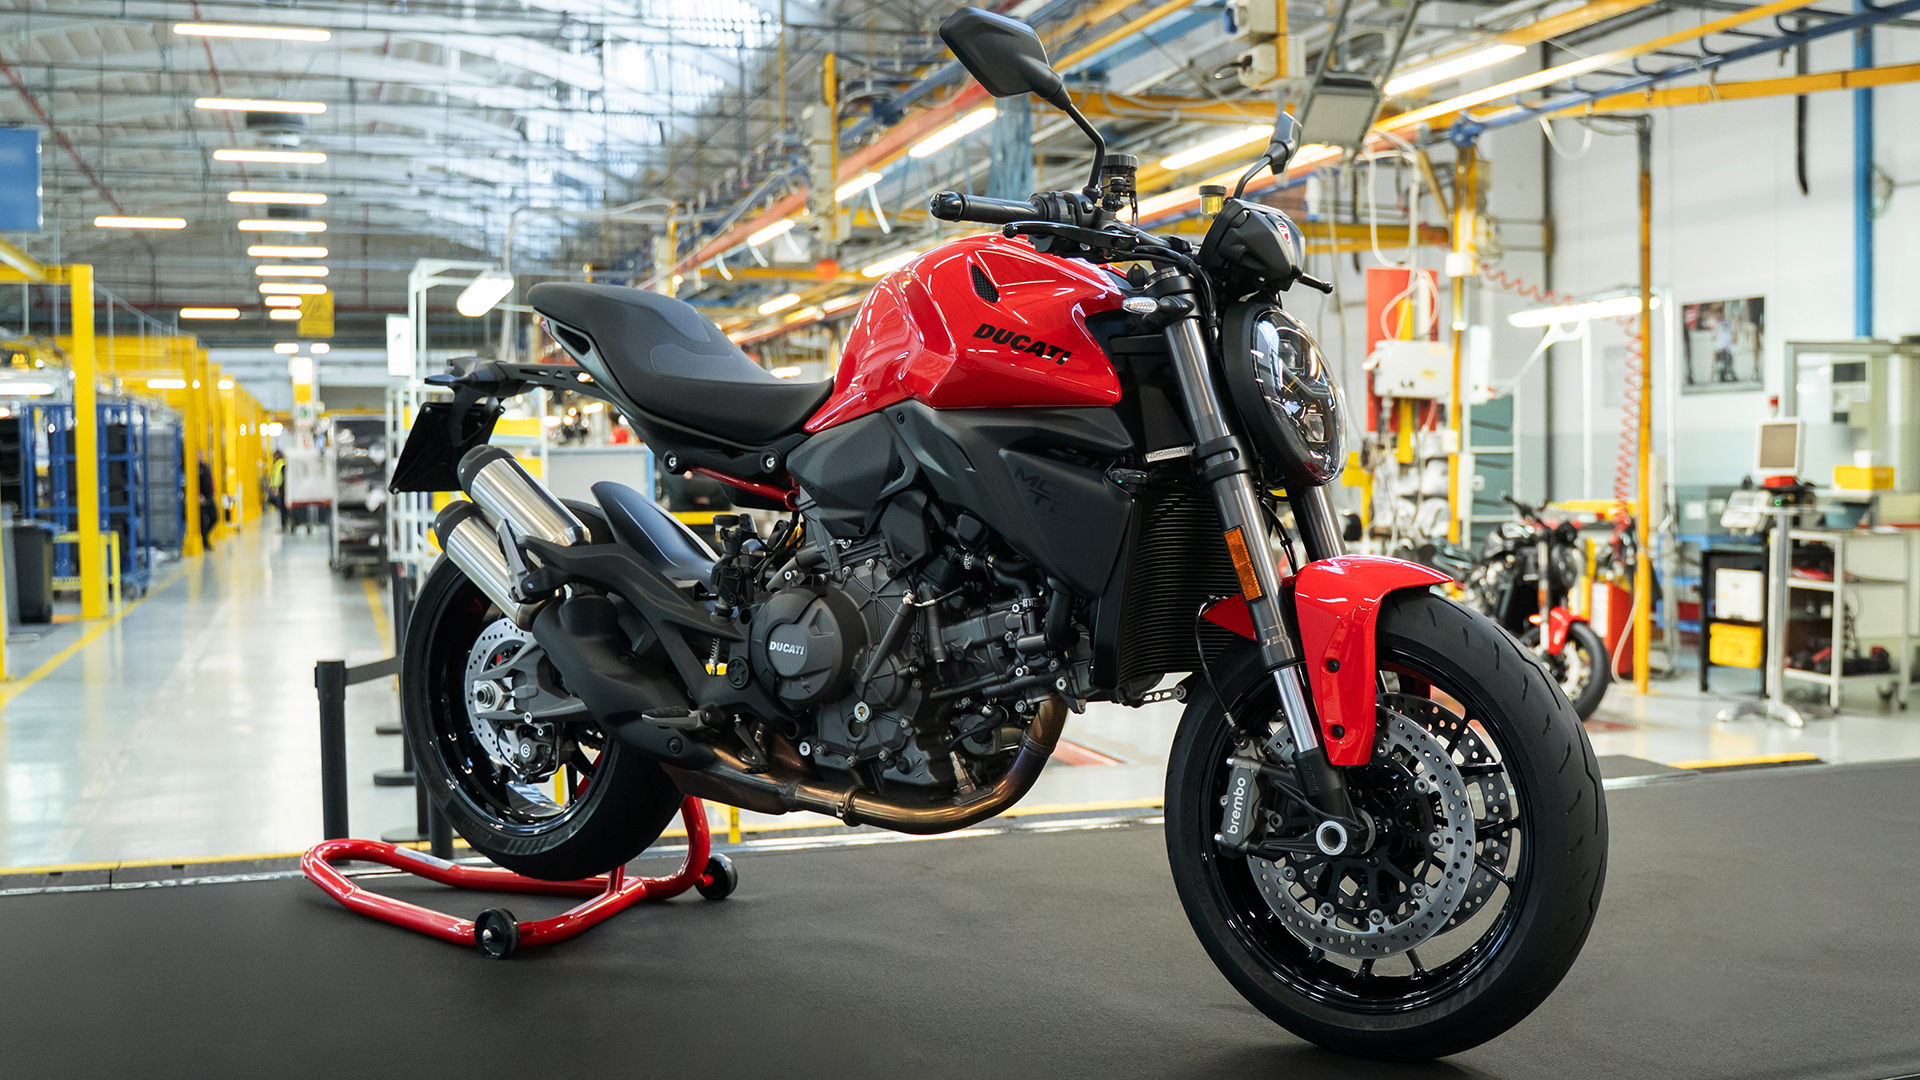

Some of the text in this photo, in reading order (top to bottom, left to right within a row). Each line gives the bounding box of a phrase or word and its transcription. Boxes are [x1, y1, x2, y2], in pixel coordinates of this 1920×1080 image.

[973, 323, 1073, 366] DUCATI
[769, 641, 804, 656] DUCATI
[1227, 777, 1246, 835] brembo
